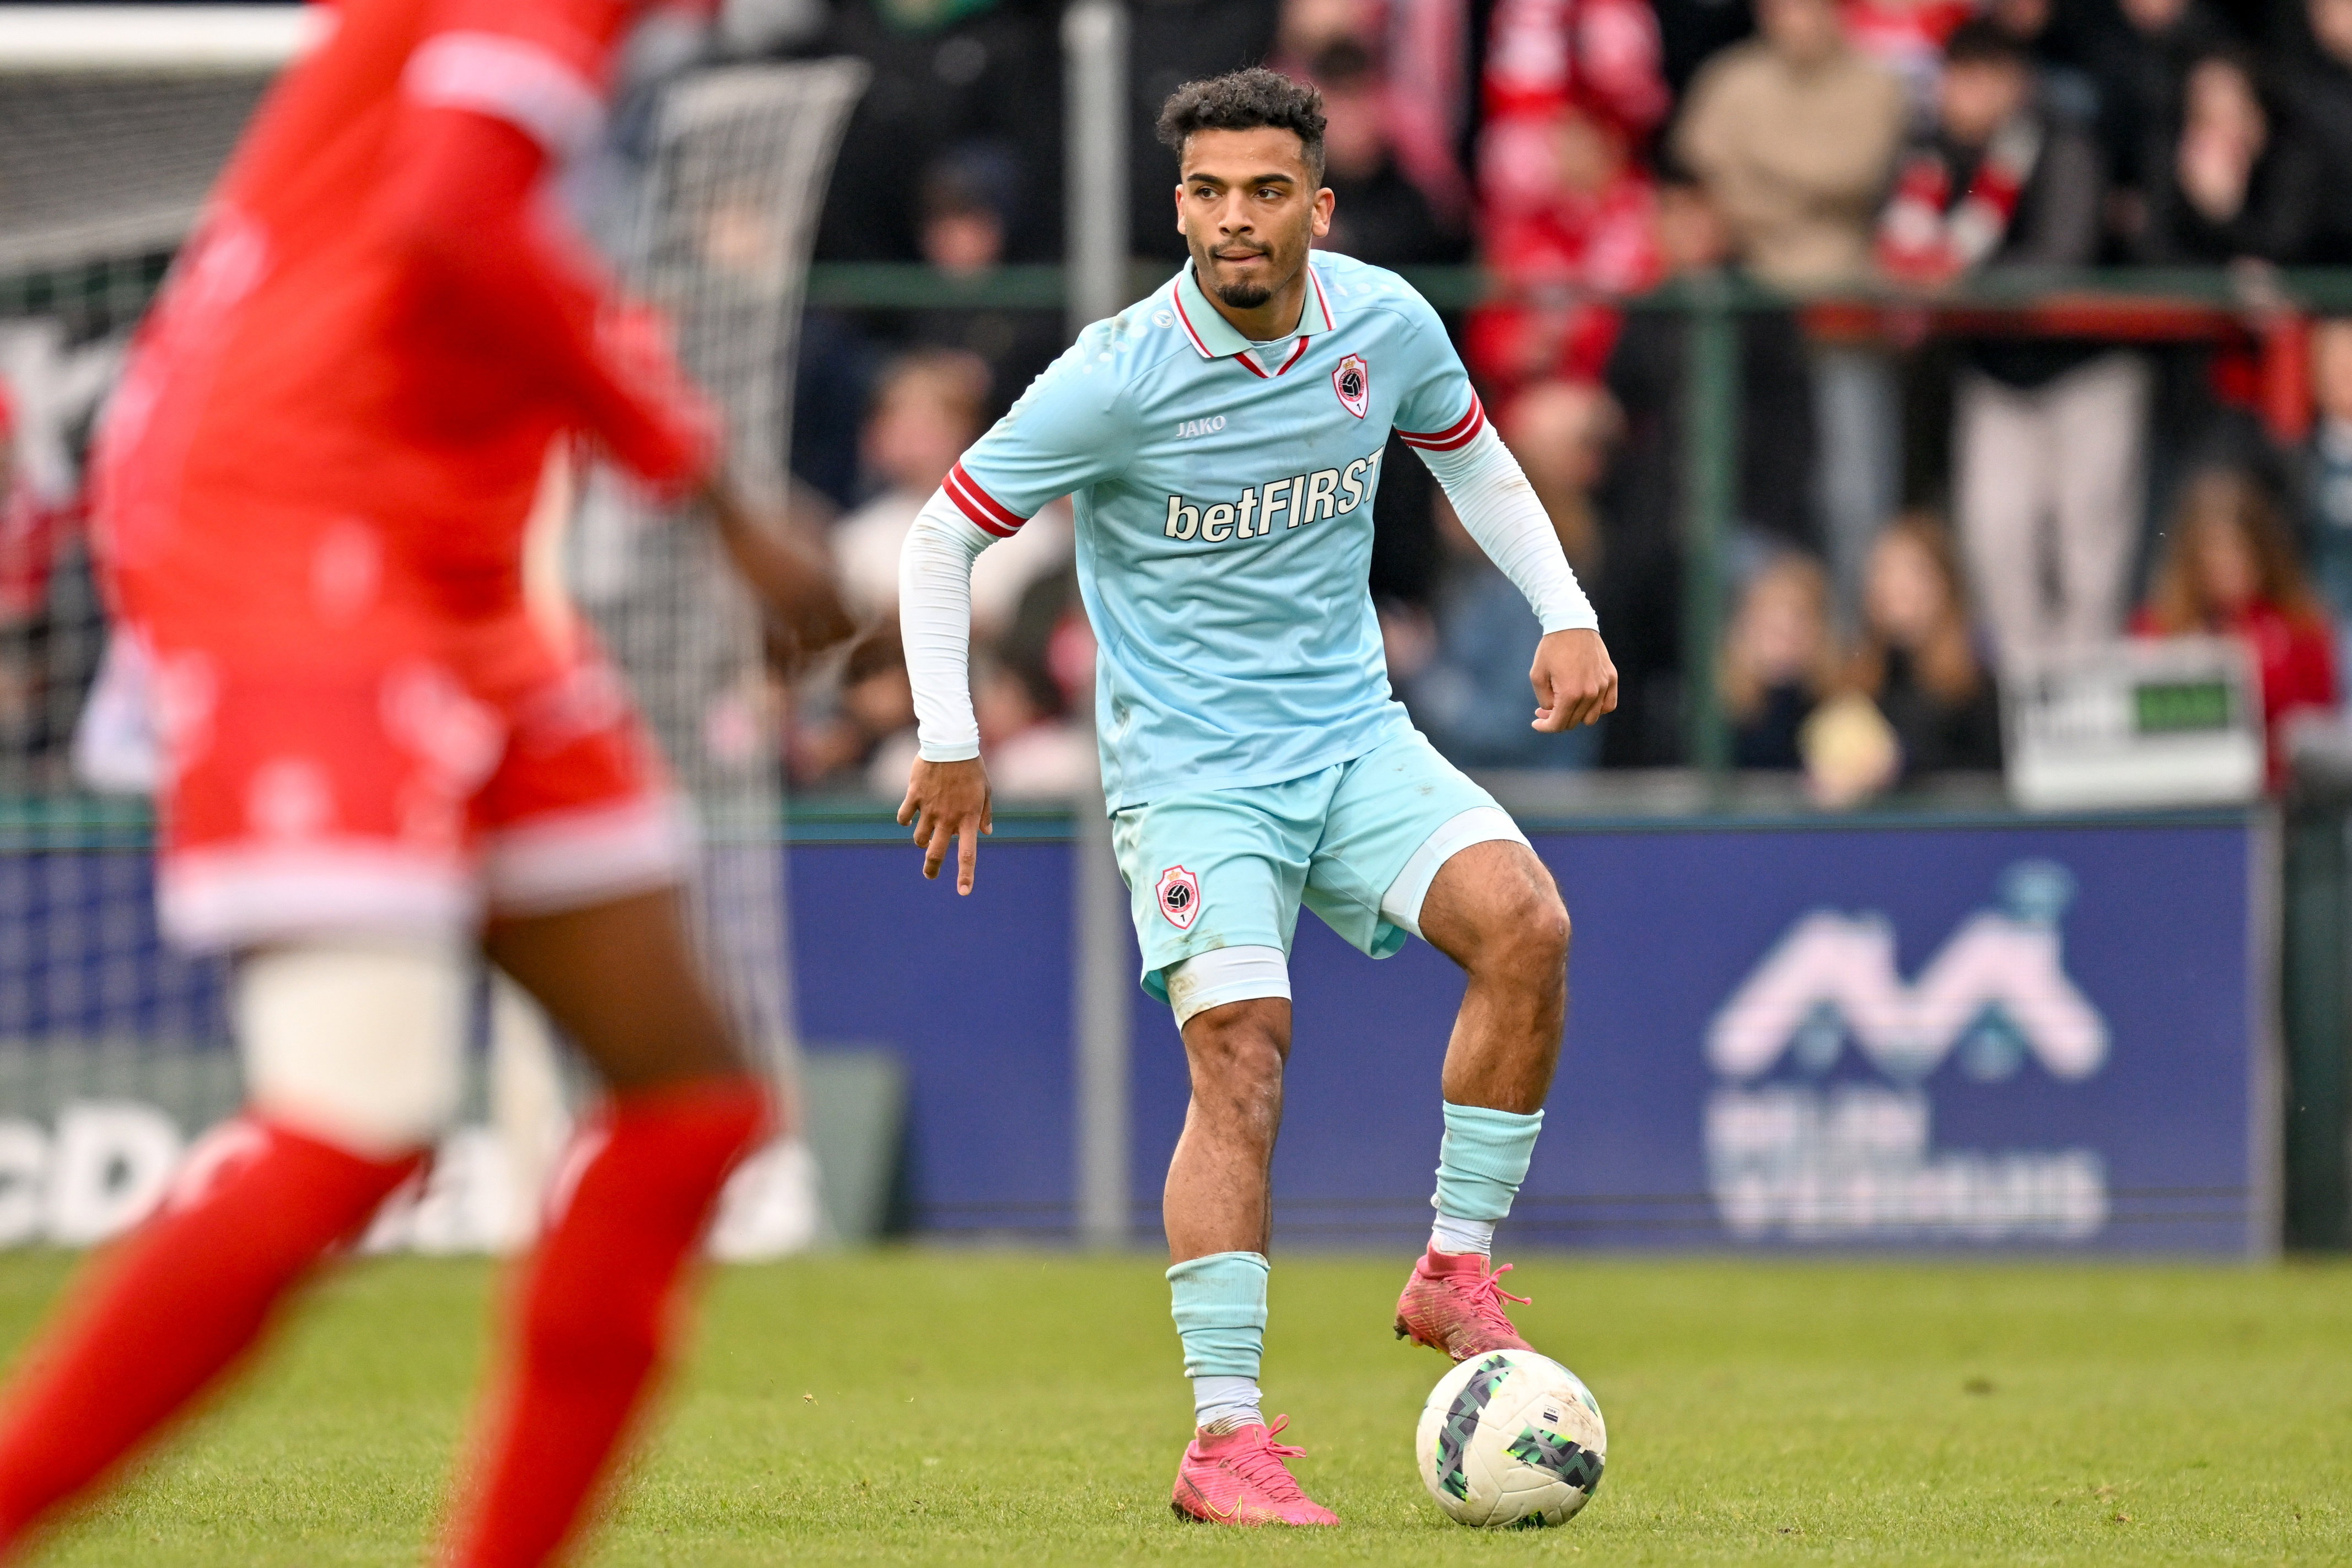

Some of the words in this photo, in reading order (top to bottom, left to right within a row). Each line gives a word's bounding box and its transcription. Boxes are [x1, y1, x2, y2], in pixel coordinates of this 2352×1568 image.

[1357, 403, 1361, 412] 1
[1176, 415, 1226, 439] JAKO
[1164, 444, 1385, 543] betFIRST
[1180, 914, 1185, 922] 1
